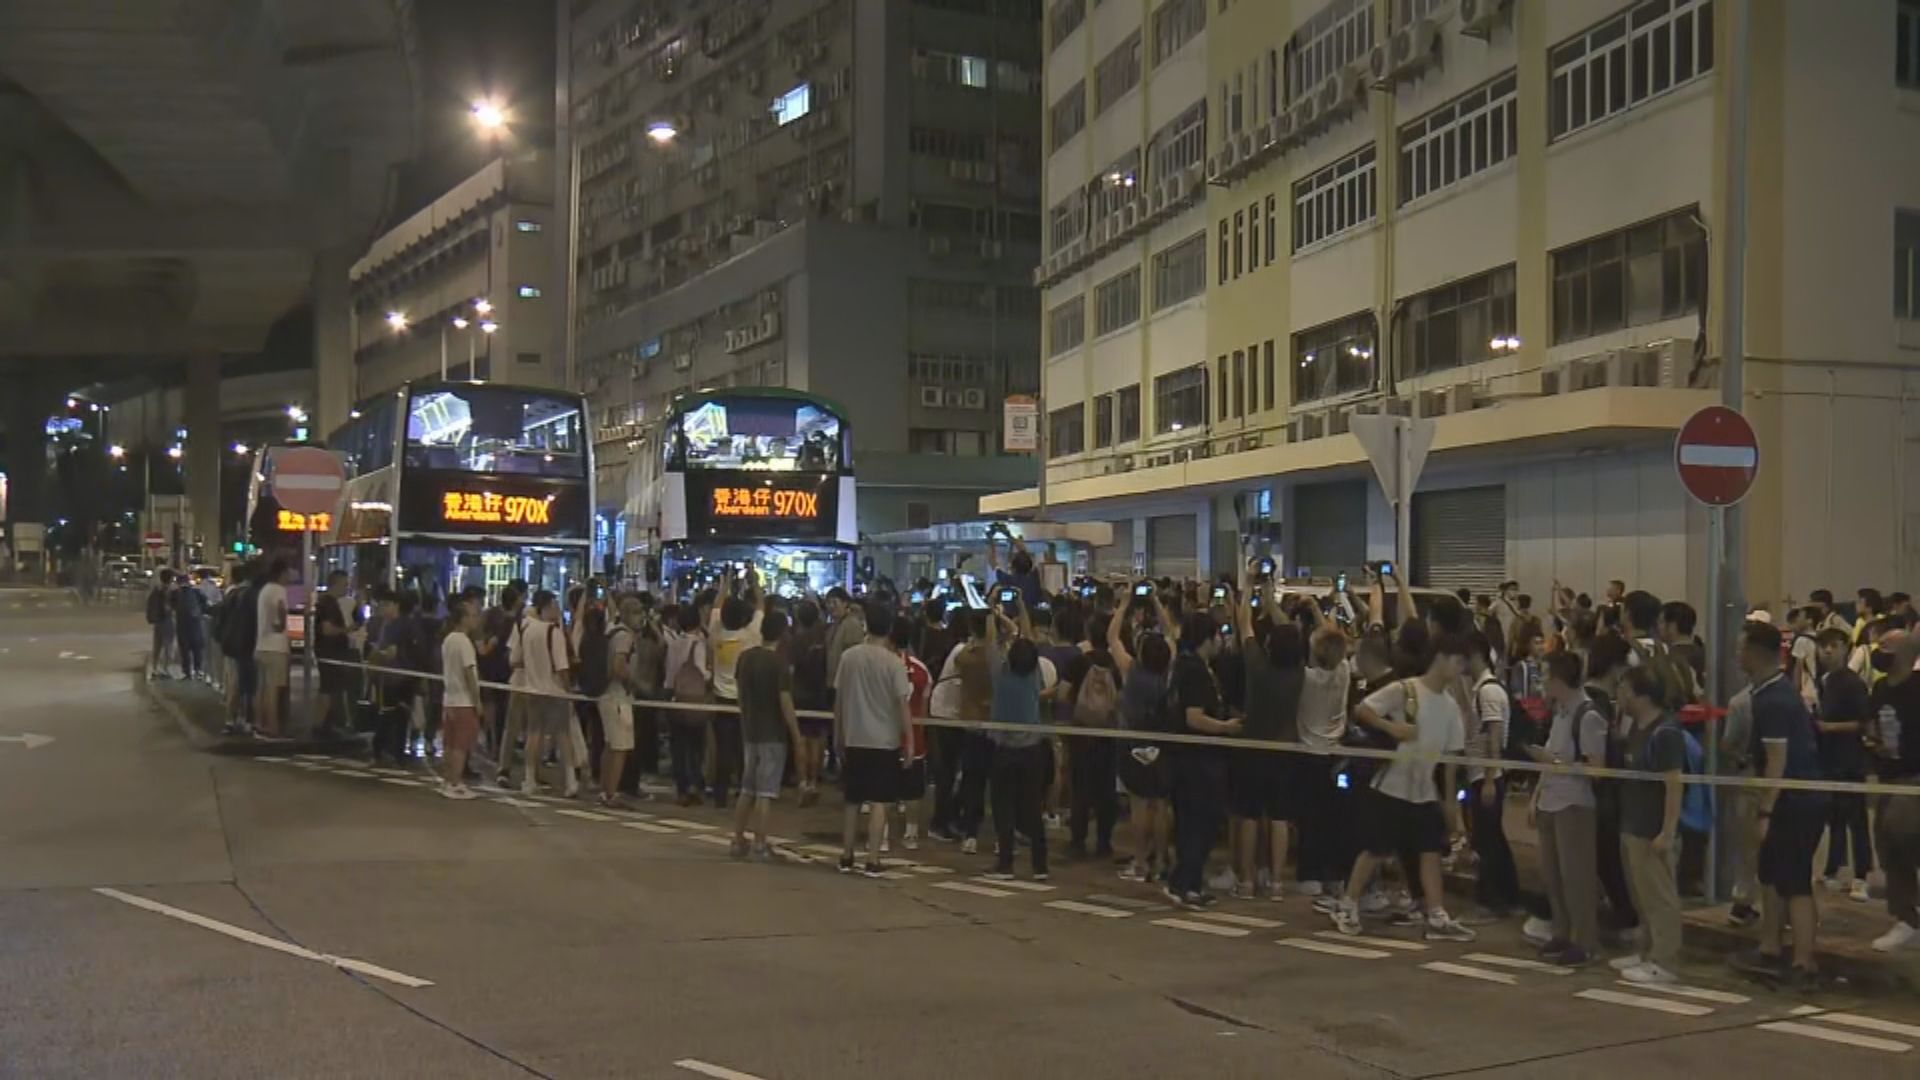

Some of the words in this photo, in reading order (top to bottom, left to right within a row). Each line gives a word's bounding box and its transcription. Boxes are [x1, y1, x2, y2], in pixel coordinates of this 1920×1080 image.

[714, 487, 771, 505] 香港仔
[774, 490, 817, 517] 970X
[504, 496, 550, 524] 970X
[714, 503, 769, 516] Aberdeen
